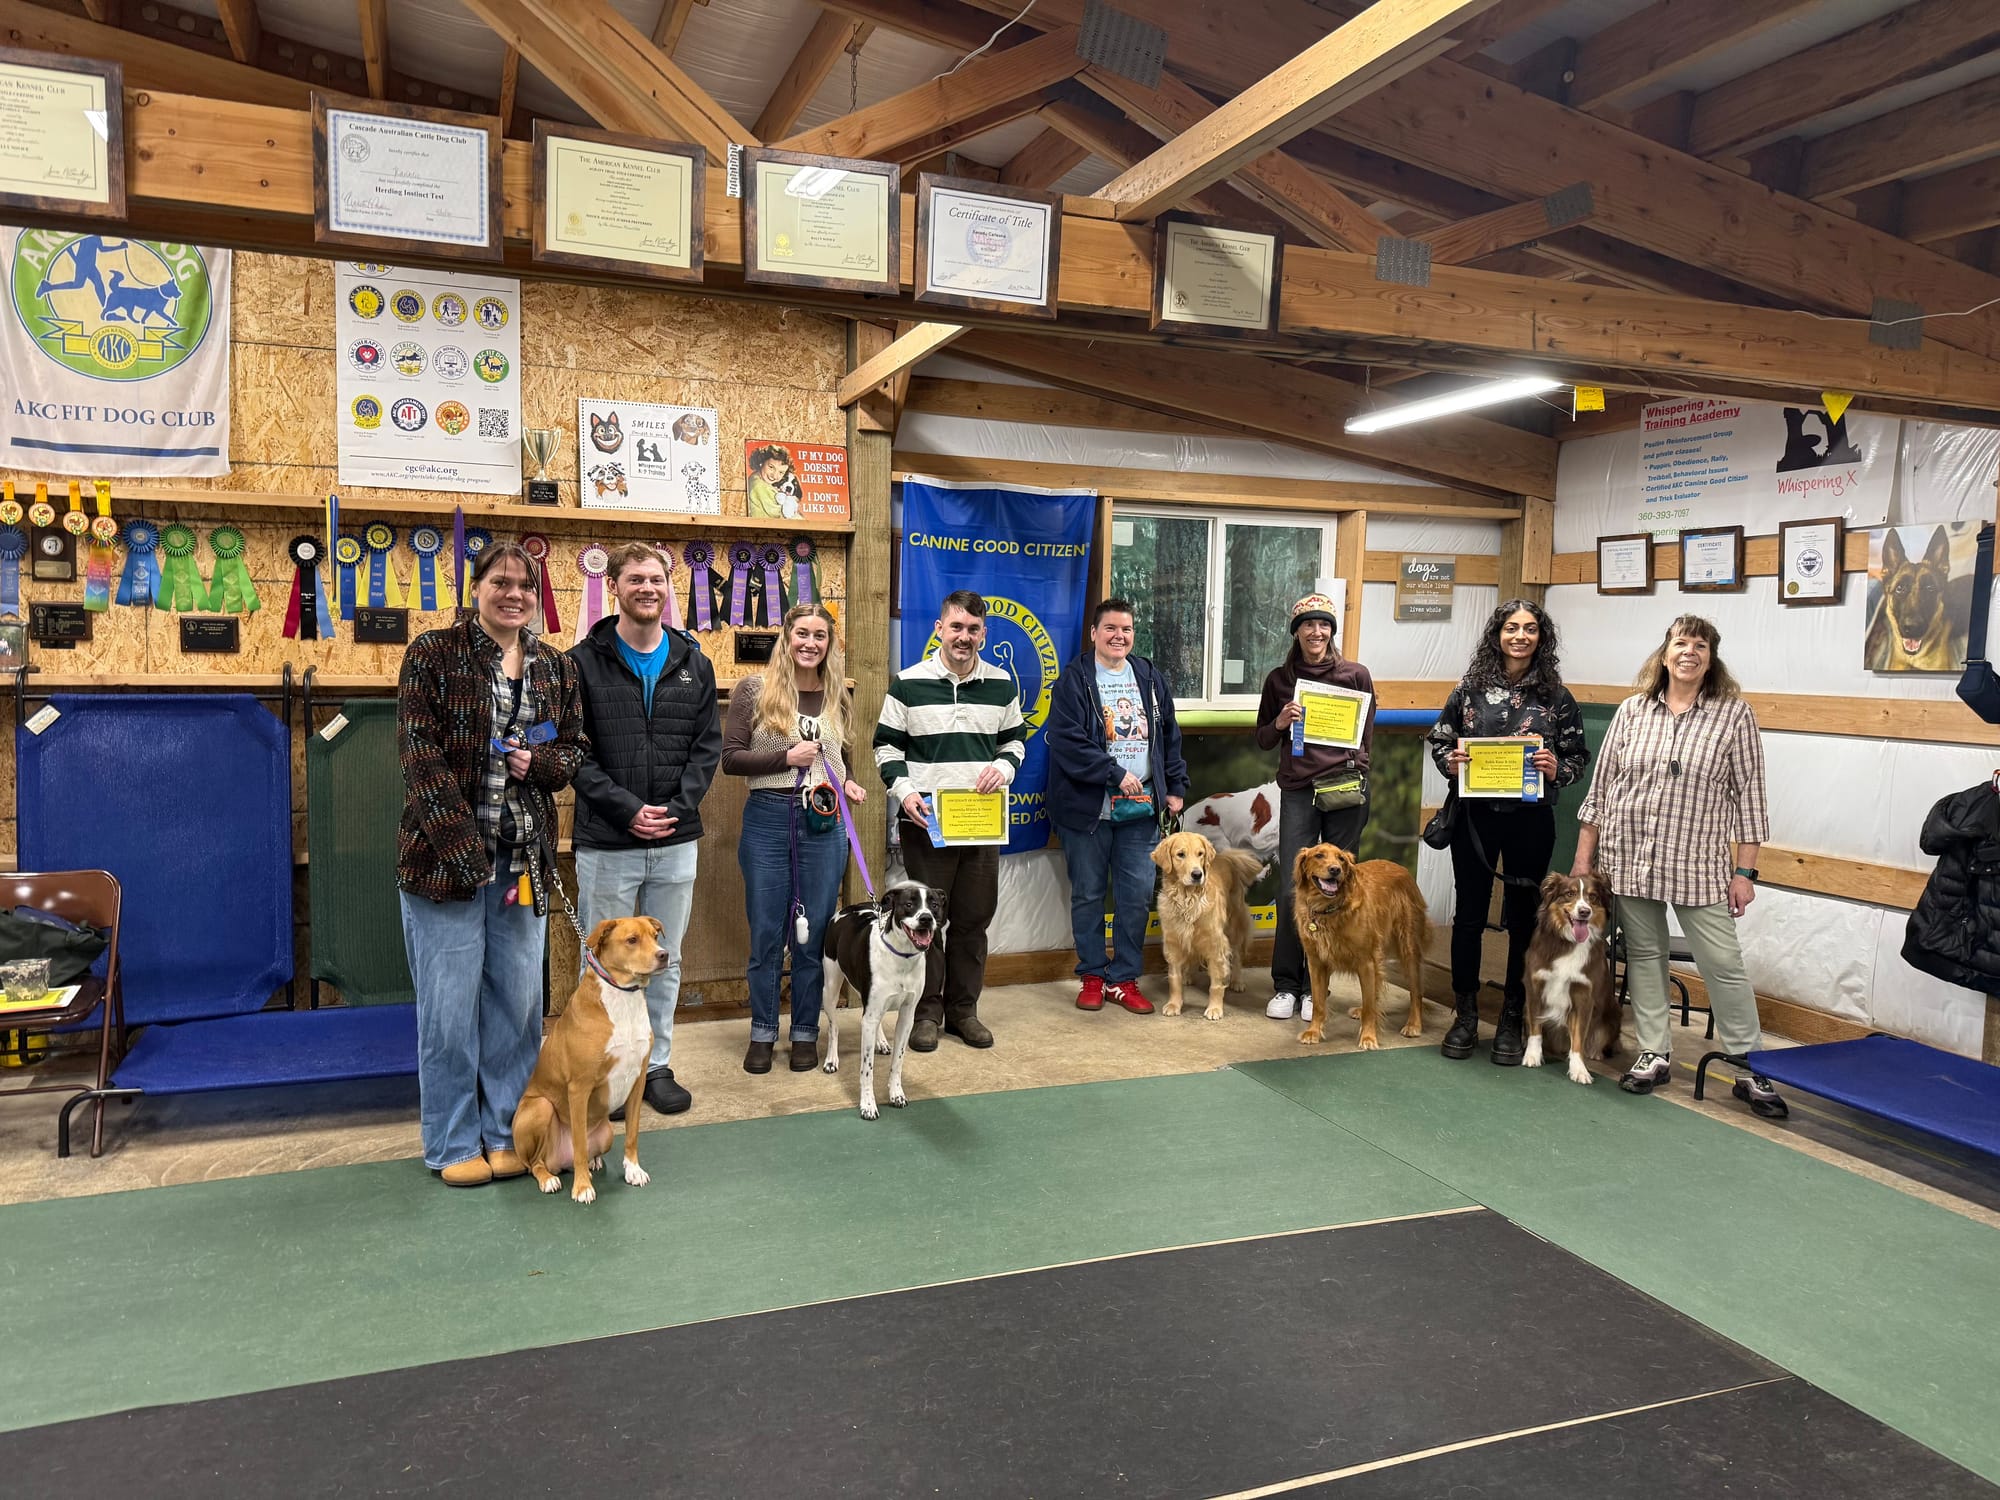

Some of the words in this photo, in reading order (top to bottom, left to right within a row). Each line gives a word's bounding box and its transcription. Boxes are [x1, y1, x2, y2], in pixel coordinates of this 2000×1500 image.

[16, 81, 43, 92] KENNEL
[47, 85, 66, 95] CLUB
[349, 123, 377, 133] Cascade
[379, 127, 413, 138] Australian
[415, 131, 434, 141] Cattle
[436, 135, 450, 143] Dog
[451, 136, 467, 145] Club
[593, 158, 620, 167] AMERICAN
[623, 162, 644, 171] KENNEL
[646, 165, 661, 174] CLUB
[375, 186, 403, 196] Herding
[404, 190, 429, 199] Instinct
[431, 192, 444, 200] Test
[949, 207, 997, 223] Certificate
[999, 215, 1012, 225] of
[1013, 216, 1033, 228] Title
[160, 240, 200, 282] OG
[100, 335, 130, 362] AKC
[354, 340, 378, 348] THERAPY
[15, 399, 58, 420] AKC
[63, 405, 97, 422] FIT
[104, 407, 156, 426] DOG
[162, 410, 216, 427] CLUB
[401, 406, 417, 420] ATT
[1646, 401, 1704, 418] Whispering
[632, 420, 665, 429] SMILES
[1645, 417, 1686, 430] Training
[1690, 407, 1740, 423] Academy
[1666, 433, 1712, 445] Reinforcement
[1713, 431, 1733, 439] Group
[798, 451, 808, 460] IF
[809, 451, 823, 461] MY
[826, 453, 843, 462] DOG
[1672, 457, 1709, 467] Obedience,
[405, 464, 458, 476] cgc@akc.org
[804, 463, 840, 474] DOESN'T
[1673, 469, 1707, 478] Behavioral
[1708, 467, 1728, 475] Issues
[801, 474, 824, 484] LIKE
[1646, 483, 1671, 492] Certified
[1709, 477, 1726, 485] Good
[1727, 475, 1748, 483] Citizen
[1777, 474, 1844, 498] Whispering
[1846, 470, 1858, 487] X
[808, 492, 811, 501] I
[814, 493, 840, 502] DON'T
[1674, 492, 1701, 500] Evaluator
[803, 504, 825, 513] LIKE
[827, 505, 847, 514] YOU.
[909, 532, 970, 552] CANINE
[973, 539, 1020, 555] GOOD
[1408, 558, 1439, 581] dogs
[1022, 614, 1057, 689] CITIZEN
